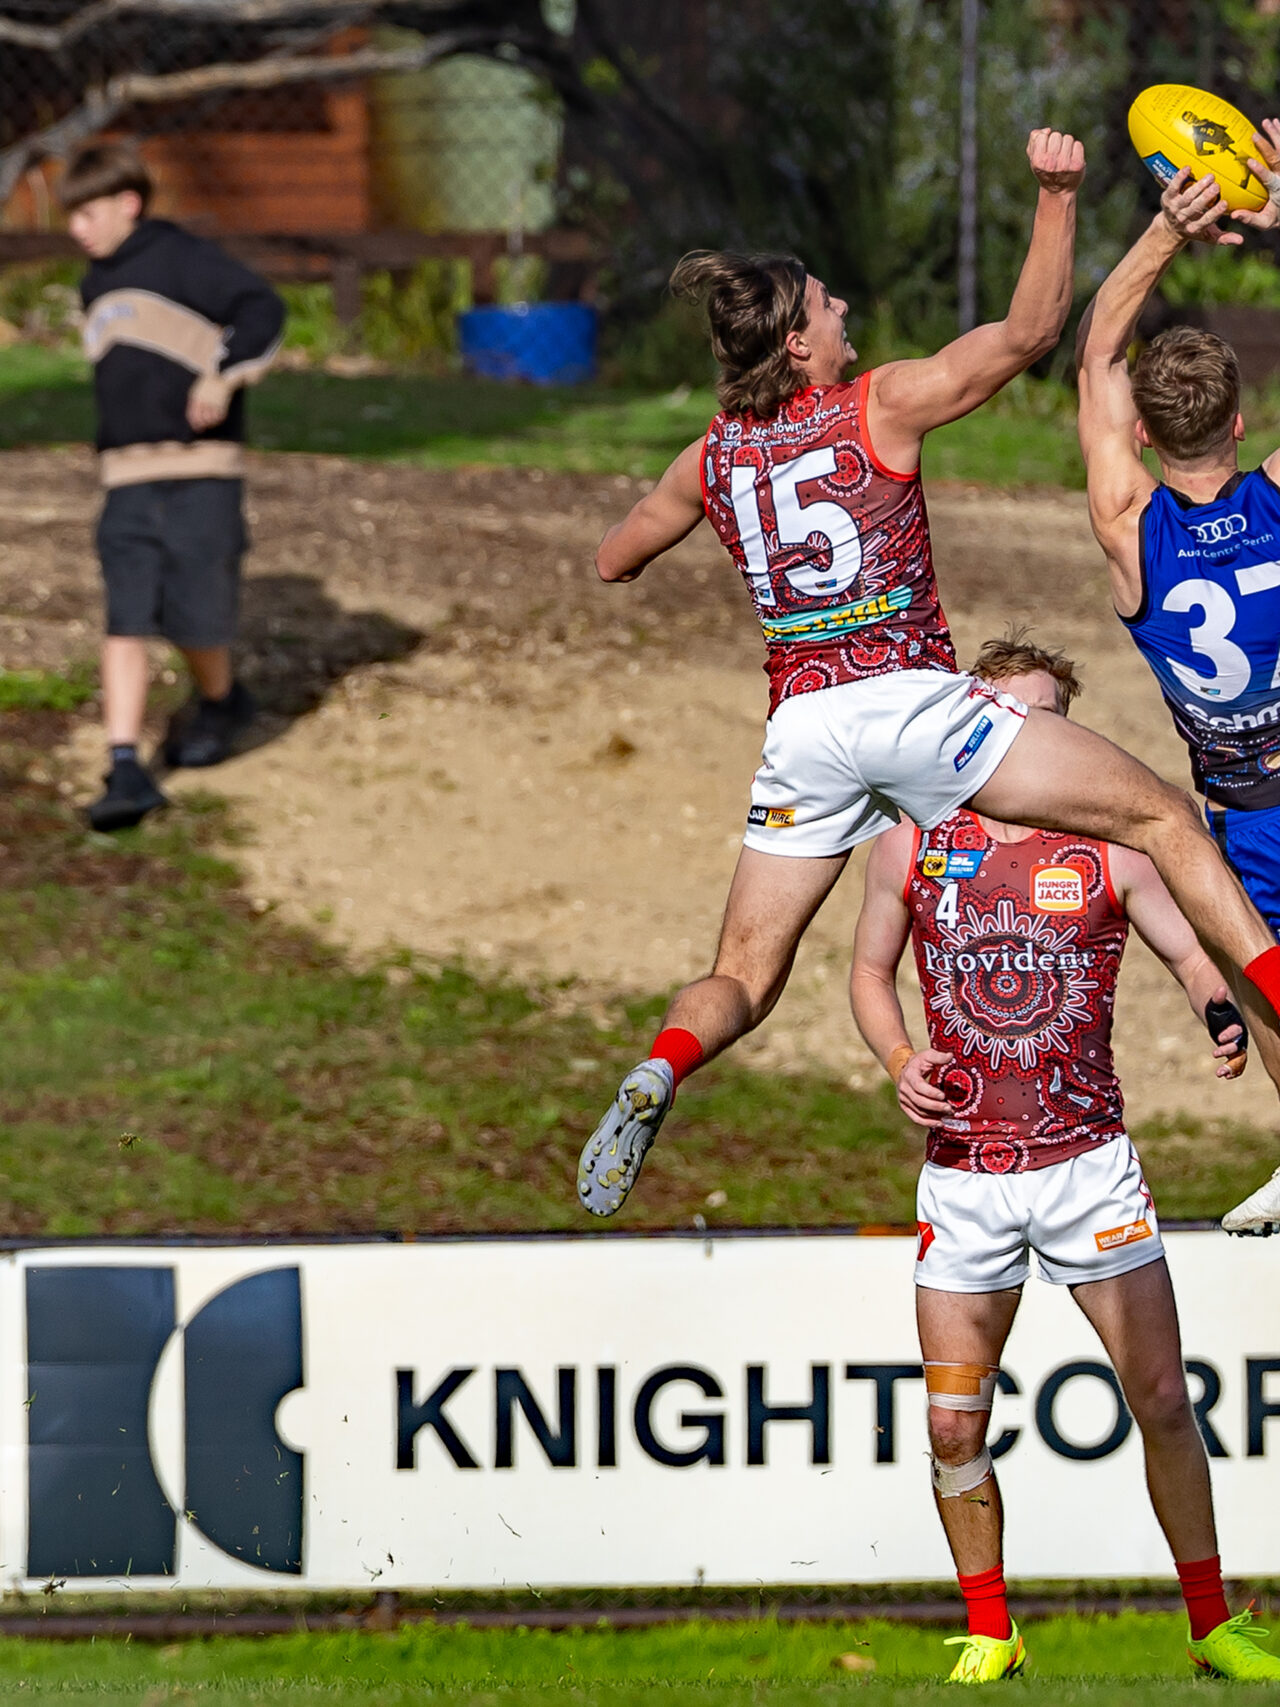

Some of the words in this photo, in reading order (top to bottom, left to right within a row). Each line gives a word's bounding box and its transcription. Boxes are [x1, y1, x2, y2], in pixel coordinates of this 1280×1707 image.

[772, 422, 802, 433] Town
[731, 446, 863, 606] 15
[1202, 543, 1241, 558] Centre
[1241, 533, 1274, 547] Perth
[770, 811, 791, 824] HIRE
[1037, 881, 1079, 889] HUNGRY
[935, 882, 960, 930] 4
